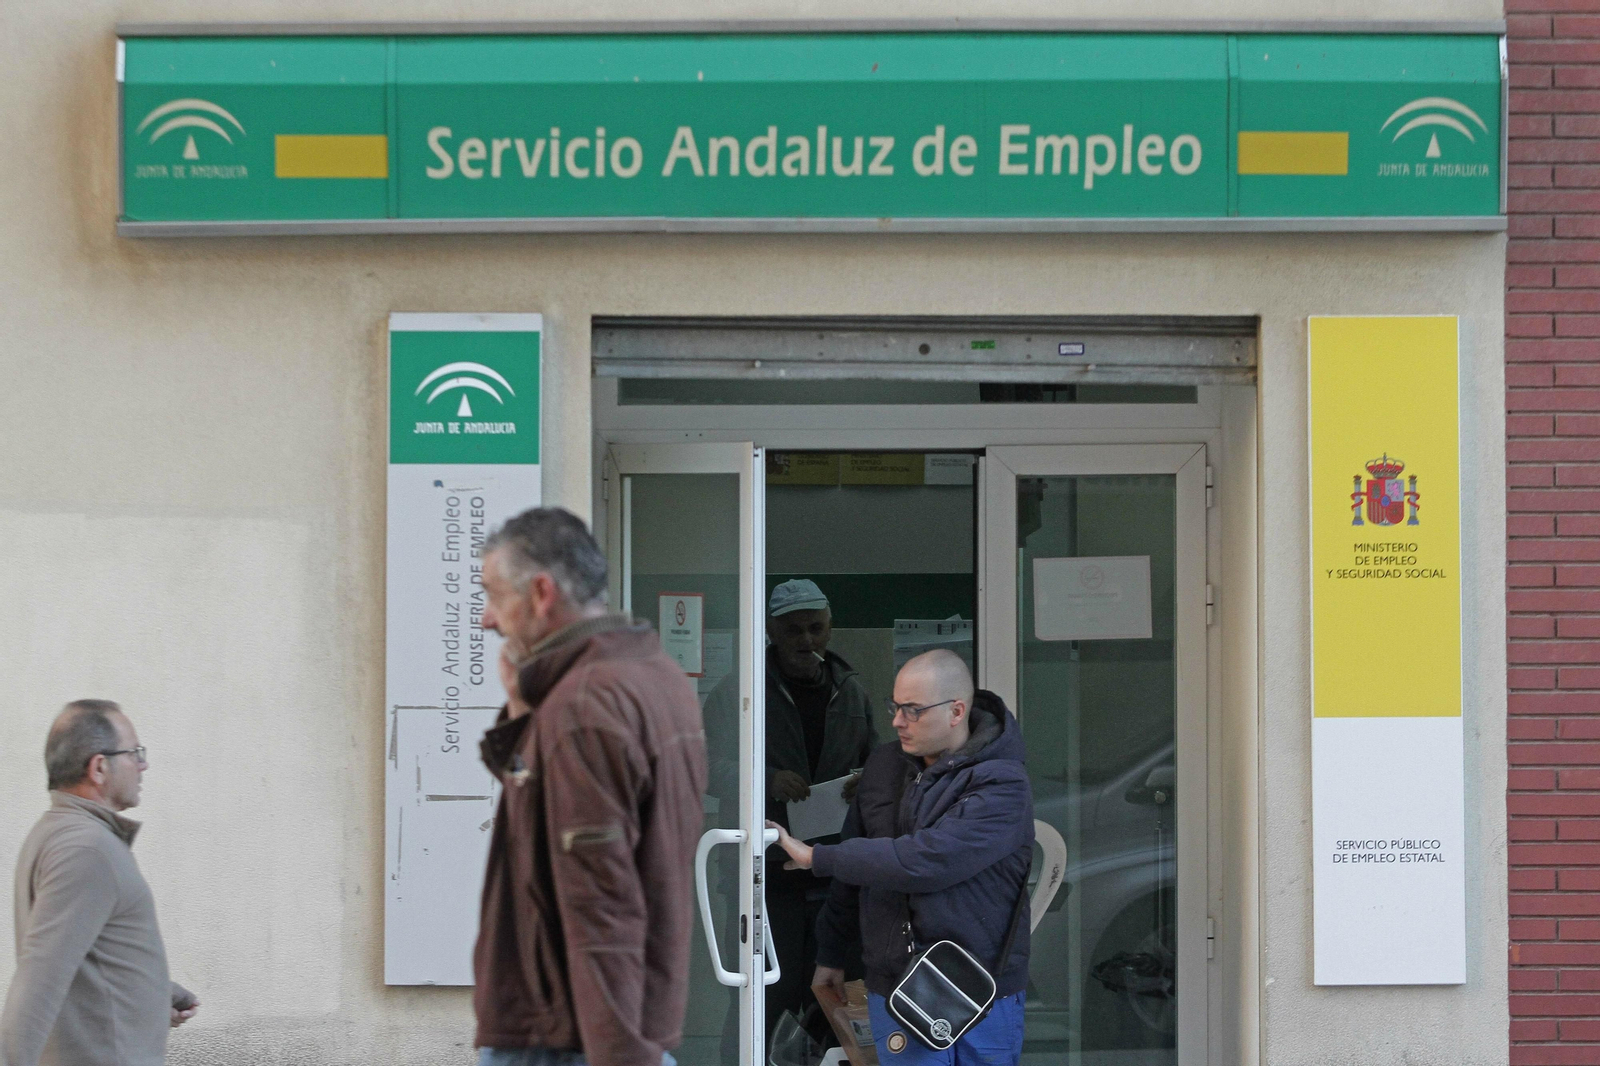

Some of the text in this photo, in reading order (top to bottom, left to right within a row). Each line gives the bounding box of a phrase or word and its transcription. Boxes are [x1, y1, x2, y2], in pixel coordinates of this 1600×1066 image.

[425, 123, 1203, 191] Servicio Andaluz de Empleo
[135, 165, 169, 178] JUNTA
[1377, 163, 1410, 177] JUNTA
[1415, 163, 1427, 177] DE
[413, 421, 516, 434] JUNTA DE ANDALUCIA
[1353, 542, 1418, 553] MINISTERIO
[1354, 555, 1417, 566] DE EMPLEO
[470, 564, 483, 585] DE
[1325, 568, 1446, 579] Y SEGURIDAD SOCIAL
[441, 496, 466, 753] Servicio Andaluz de Empleo
[466, 591, 484, 686] CONSEJERÍA
[1336, 837, 1441, 850] SERVICIO PÚBLICO
[1332, 852, 1446, 864] DE EMPLEO ESTATAL
